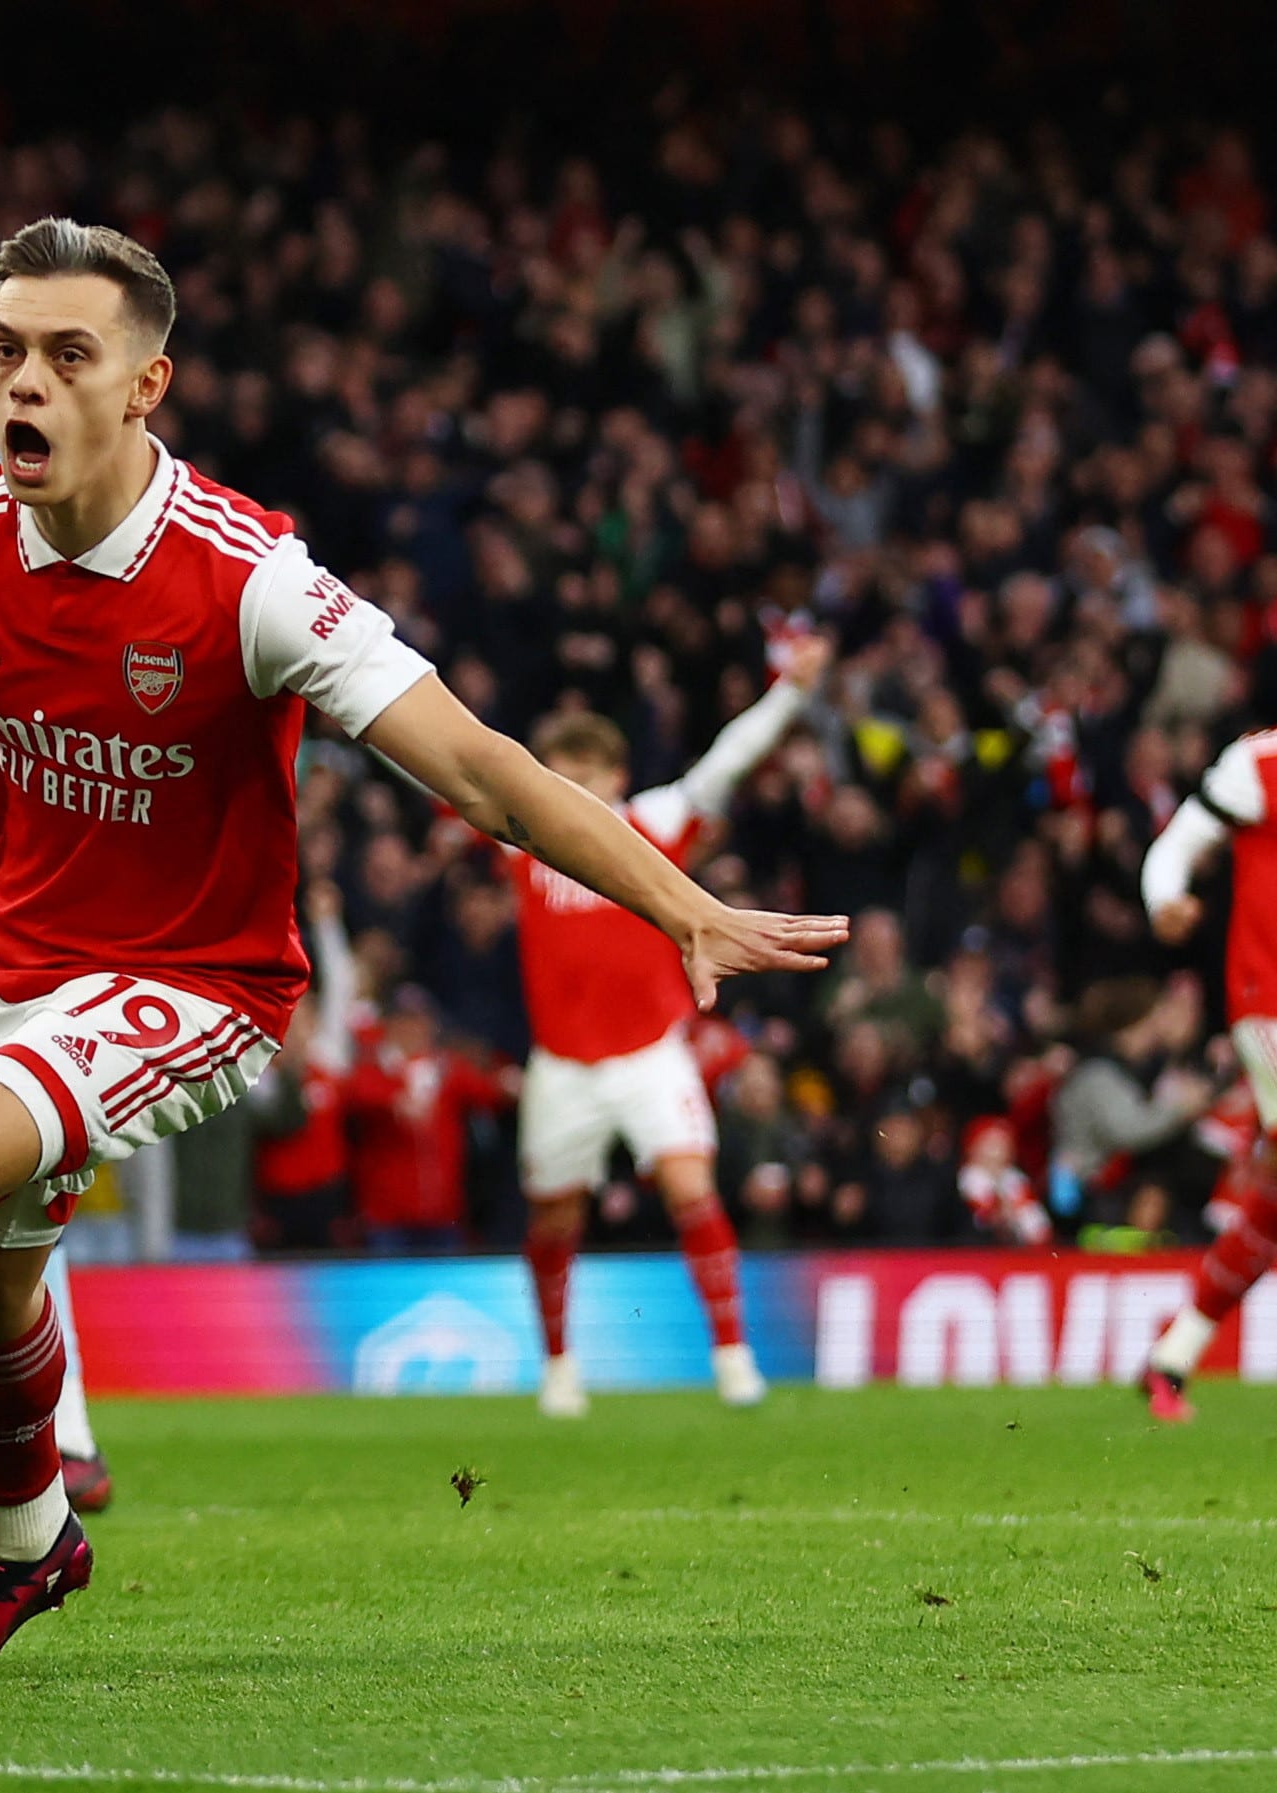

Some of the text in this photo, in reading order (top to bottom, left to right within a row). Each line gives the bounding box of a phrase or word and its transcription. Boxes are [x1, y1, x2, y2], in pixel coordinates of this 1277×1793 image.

[304, 573, 339, 600] VIS
[130, 650, 175, 668] Arsenal
[42, 767, 153, 825] BETTER
[64, 974, 181, 1049] 19
[51, 1034, 93, 1078] adidas
